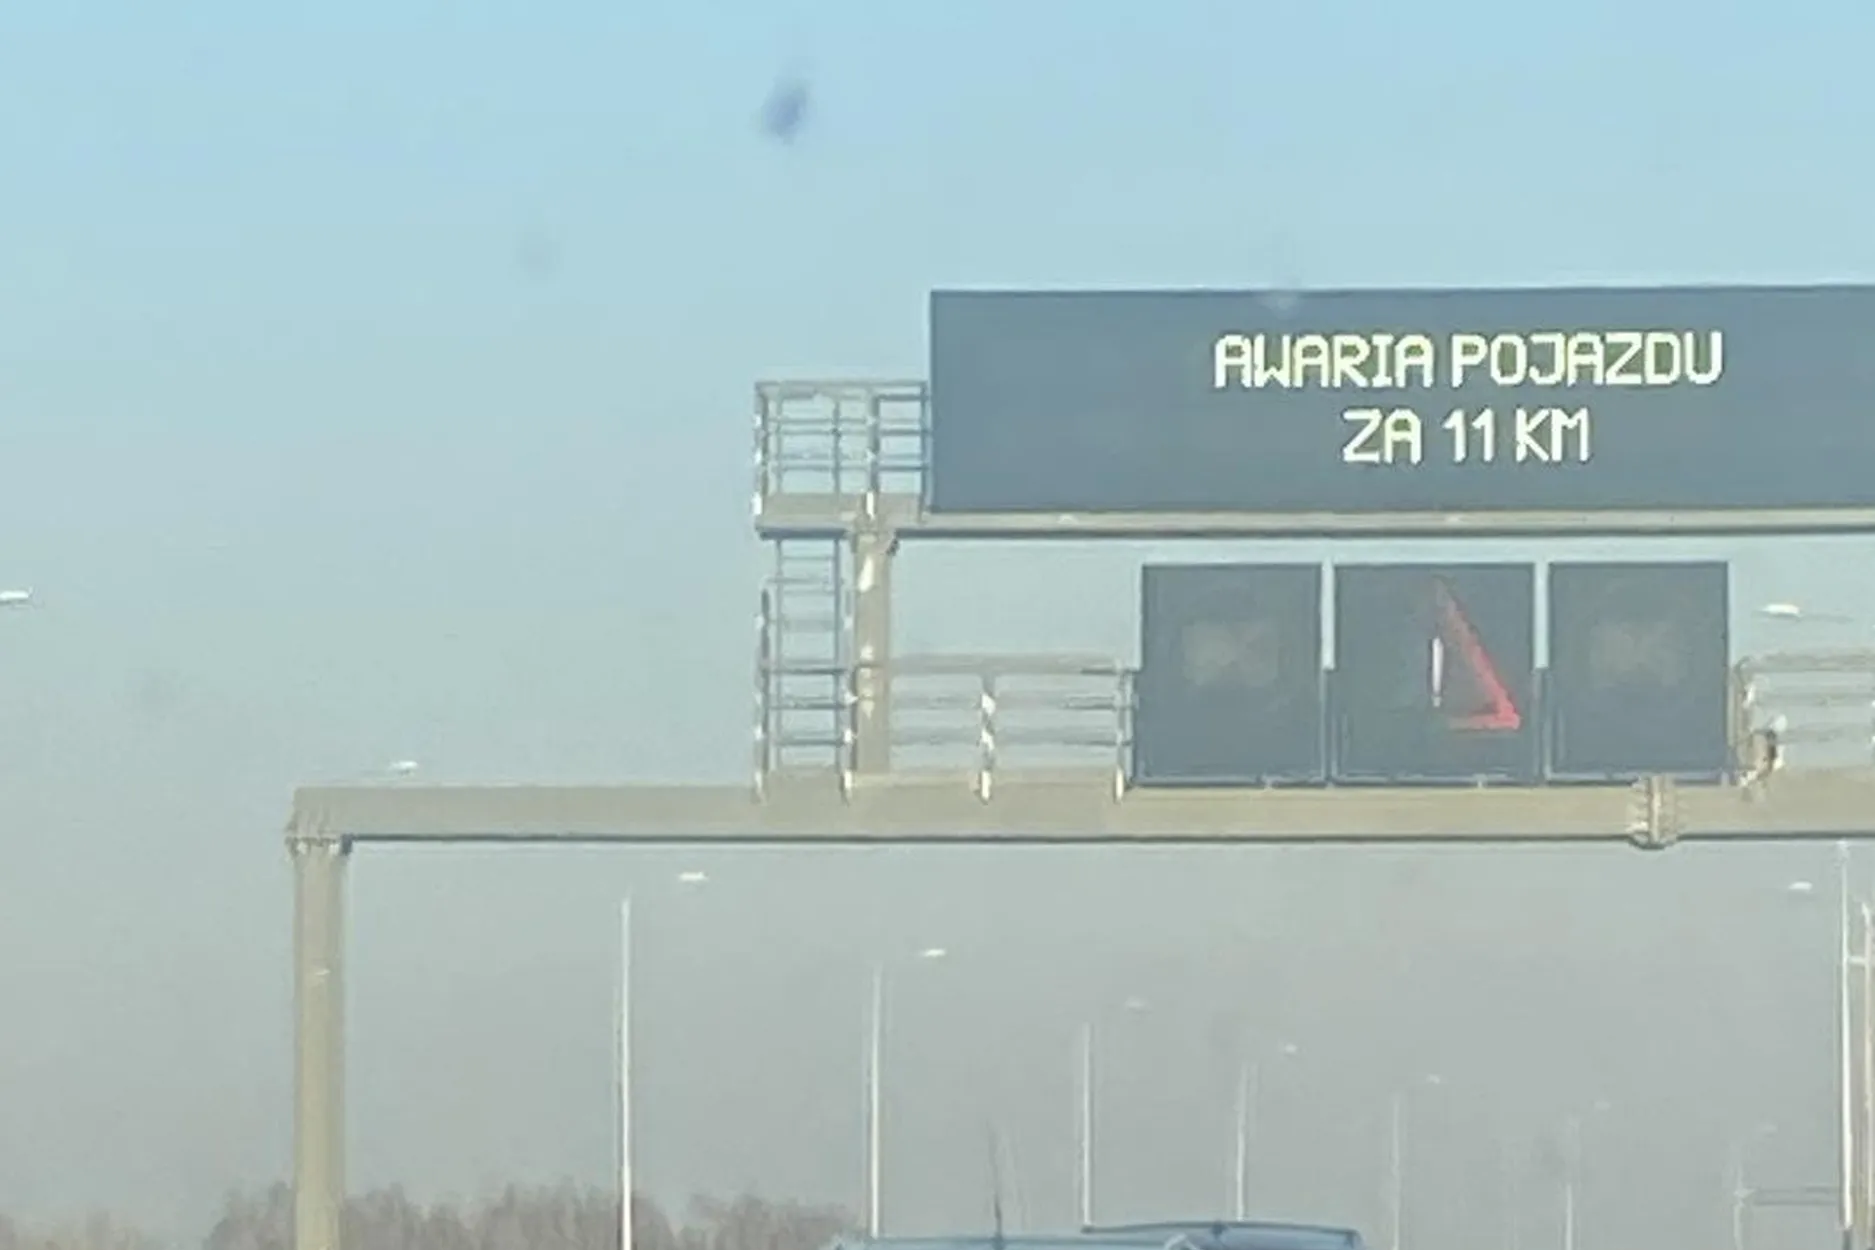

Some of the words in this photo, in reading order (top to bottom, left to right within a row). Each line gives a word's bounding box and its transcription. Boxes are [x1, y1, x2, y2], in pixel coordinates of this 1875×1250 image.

[1213, 332, 1434, 389] AWARIA
[1450, 330, 1724, 387] POJAZDU
[1341, 408, 1422, 465] ZA
[1442, 408, 1496, 464] 11
[1514, 408, 1592, 464] KM
